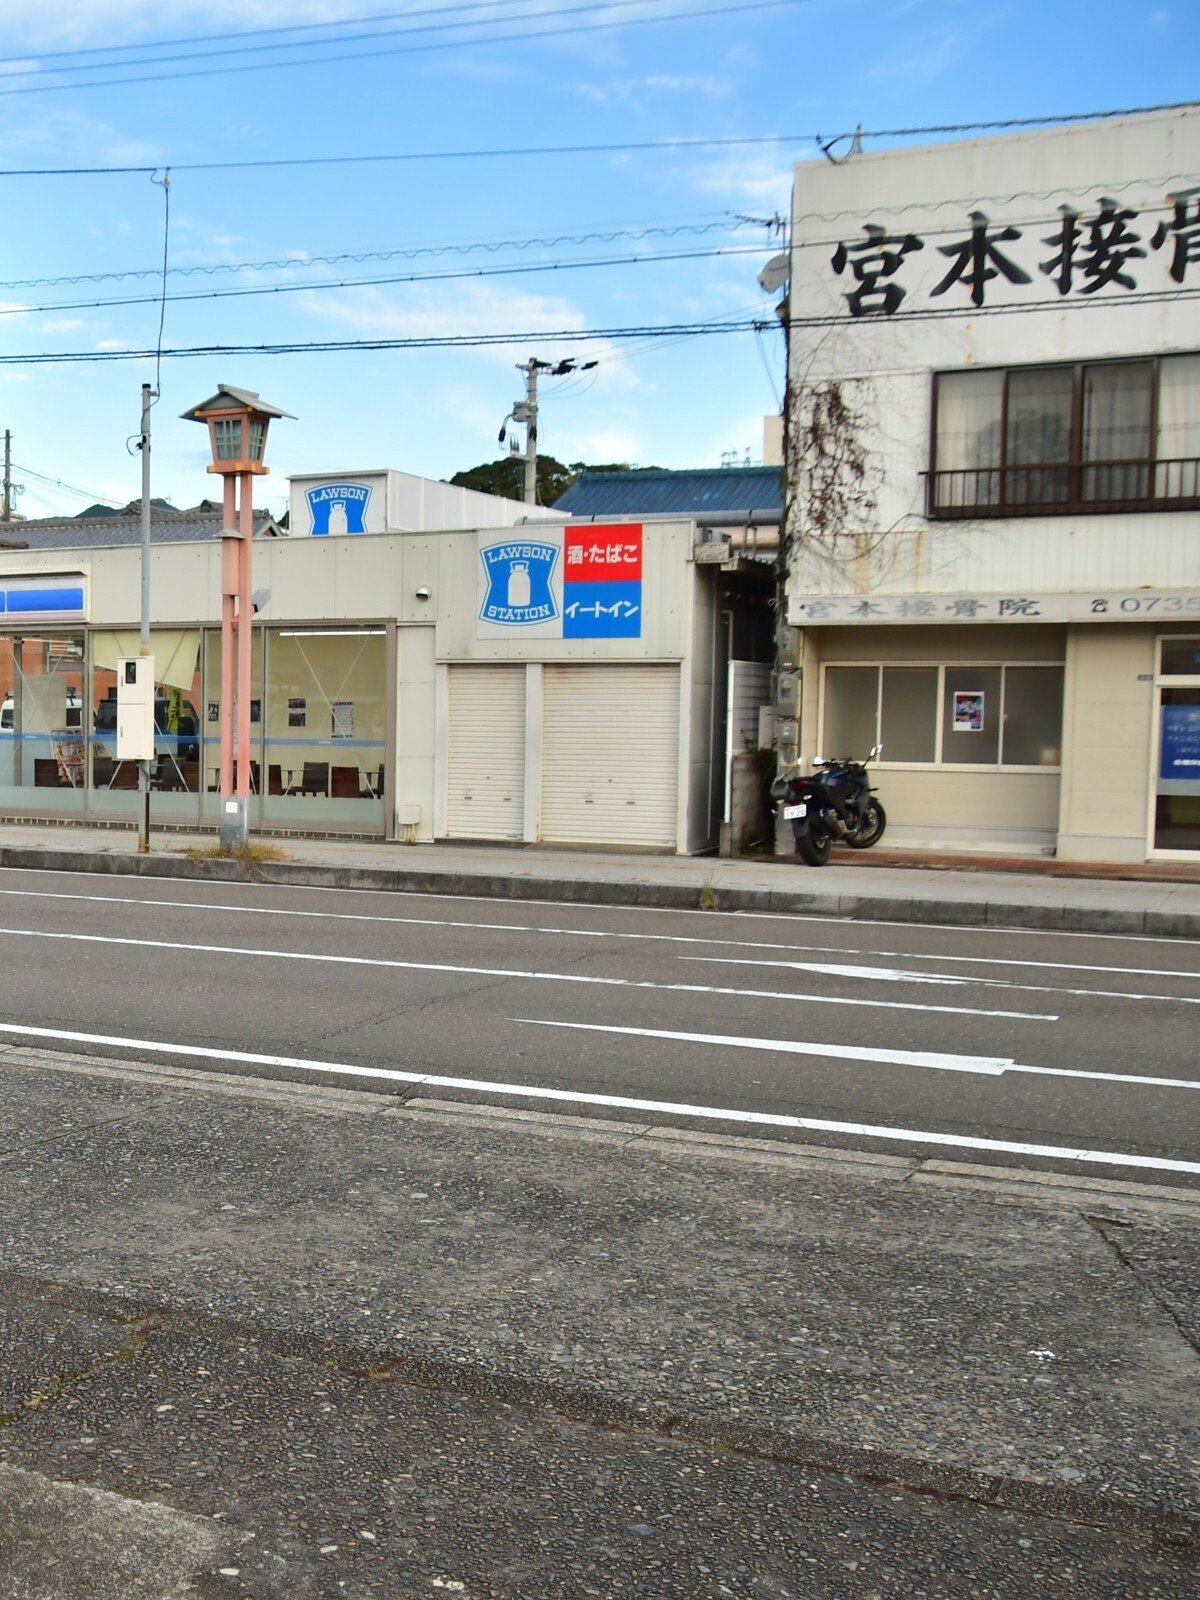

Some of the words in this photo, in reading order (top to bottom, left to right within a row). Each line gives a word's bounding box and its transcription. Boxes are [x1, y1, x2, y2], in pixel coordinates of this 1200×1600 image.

[310, 487, 366, 503] LAWSON
[487, 545, 553, 563] LAWSON
[487, 604, 551, 621] STATION
[565, 600, 639, 618] イートイン
[800, 598, 1041, 619] 宮本接骨院
